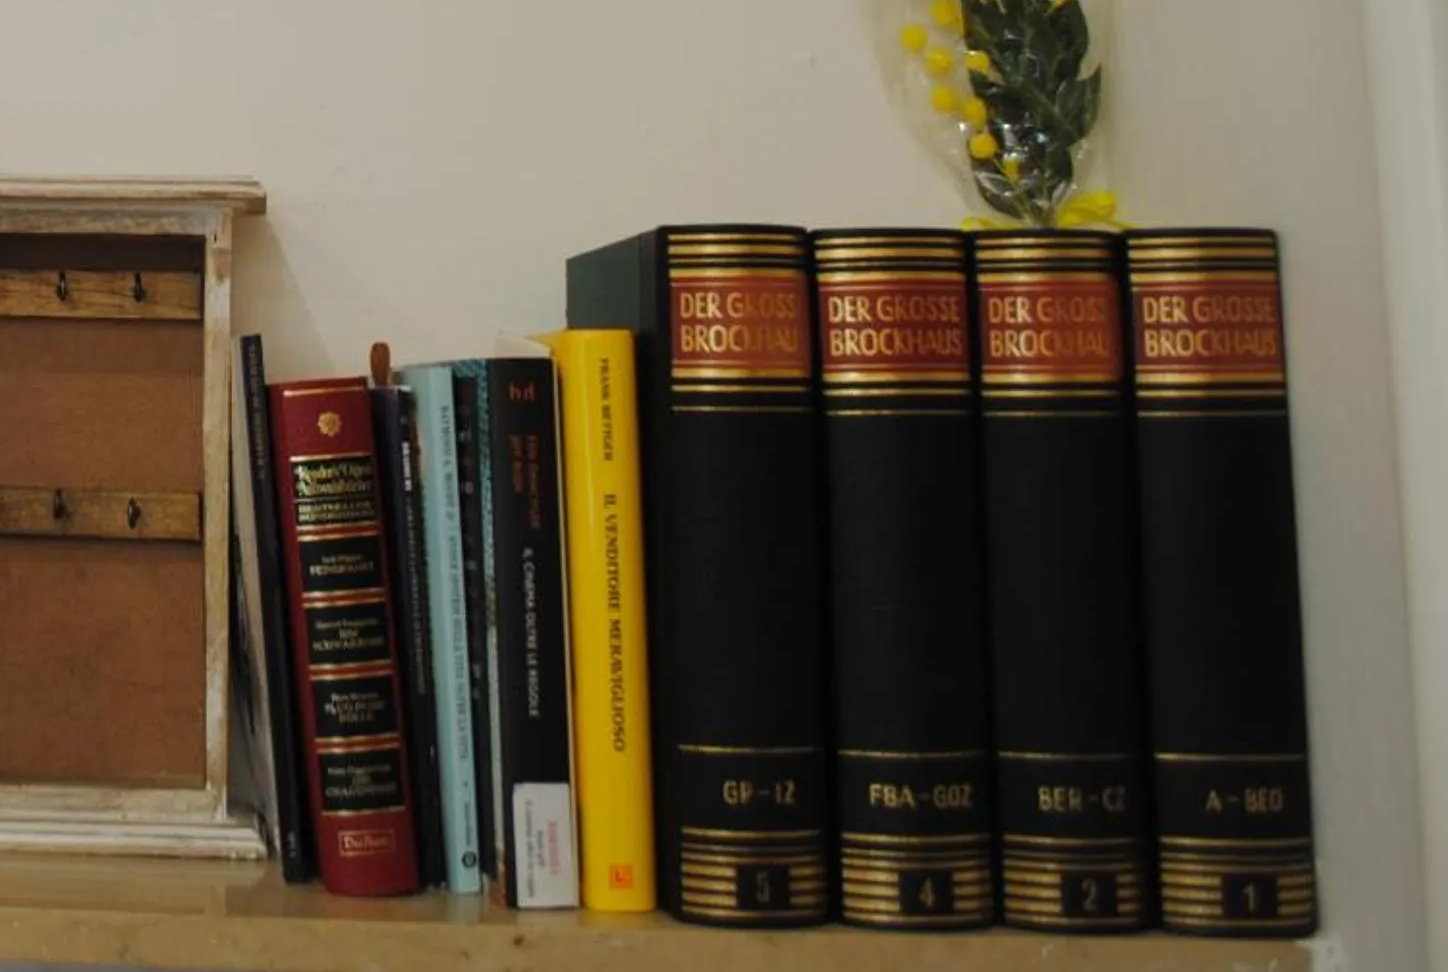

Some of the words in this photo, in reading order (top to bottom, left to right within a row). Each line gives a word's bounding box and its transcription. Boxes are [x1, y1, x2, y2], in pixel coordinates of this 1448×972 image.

[679, 291, 724, 319] DER
[827, 295, 872, 323] DER
[875, 294, 961, 323] GROSSE
[987, 295, 1033, 324] DER
[1142, 295, 1190, 324] DER
[1191, 294, 1275, 324] GROSSE
[829, 327, 963, 357] BROCKHAUS
[1143, 327, 1277, 358] BROCKHAUS
[606, 512, 622, 611] VENDITORE
[608, 618, 626, 752] MERAVIGLIOSO
[754, 869, 772, 905] 5
[918, 876, 936, 909] 4
[1080, 876, 1098, 913] 2
[1242, 880, 1258, 913] 1
